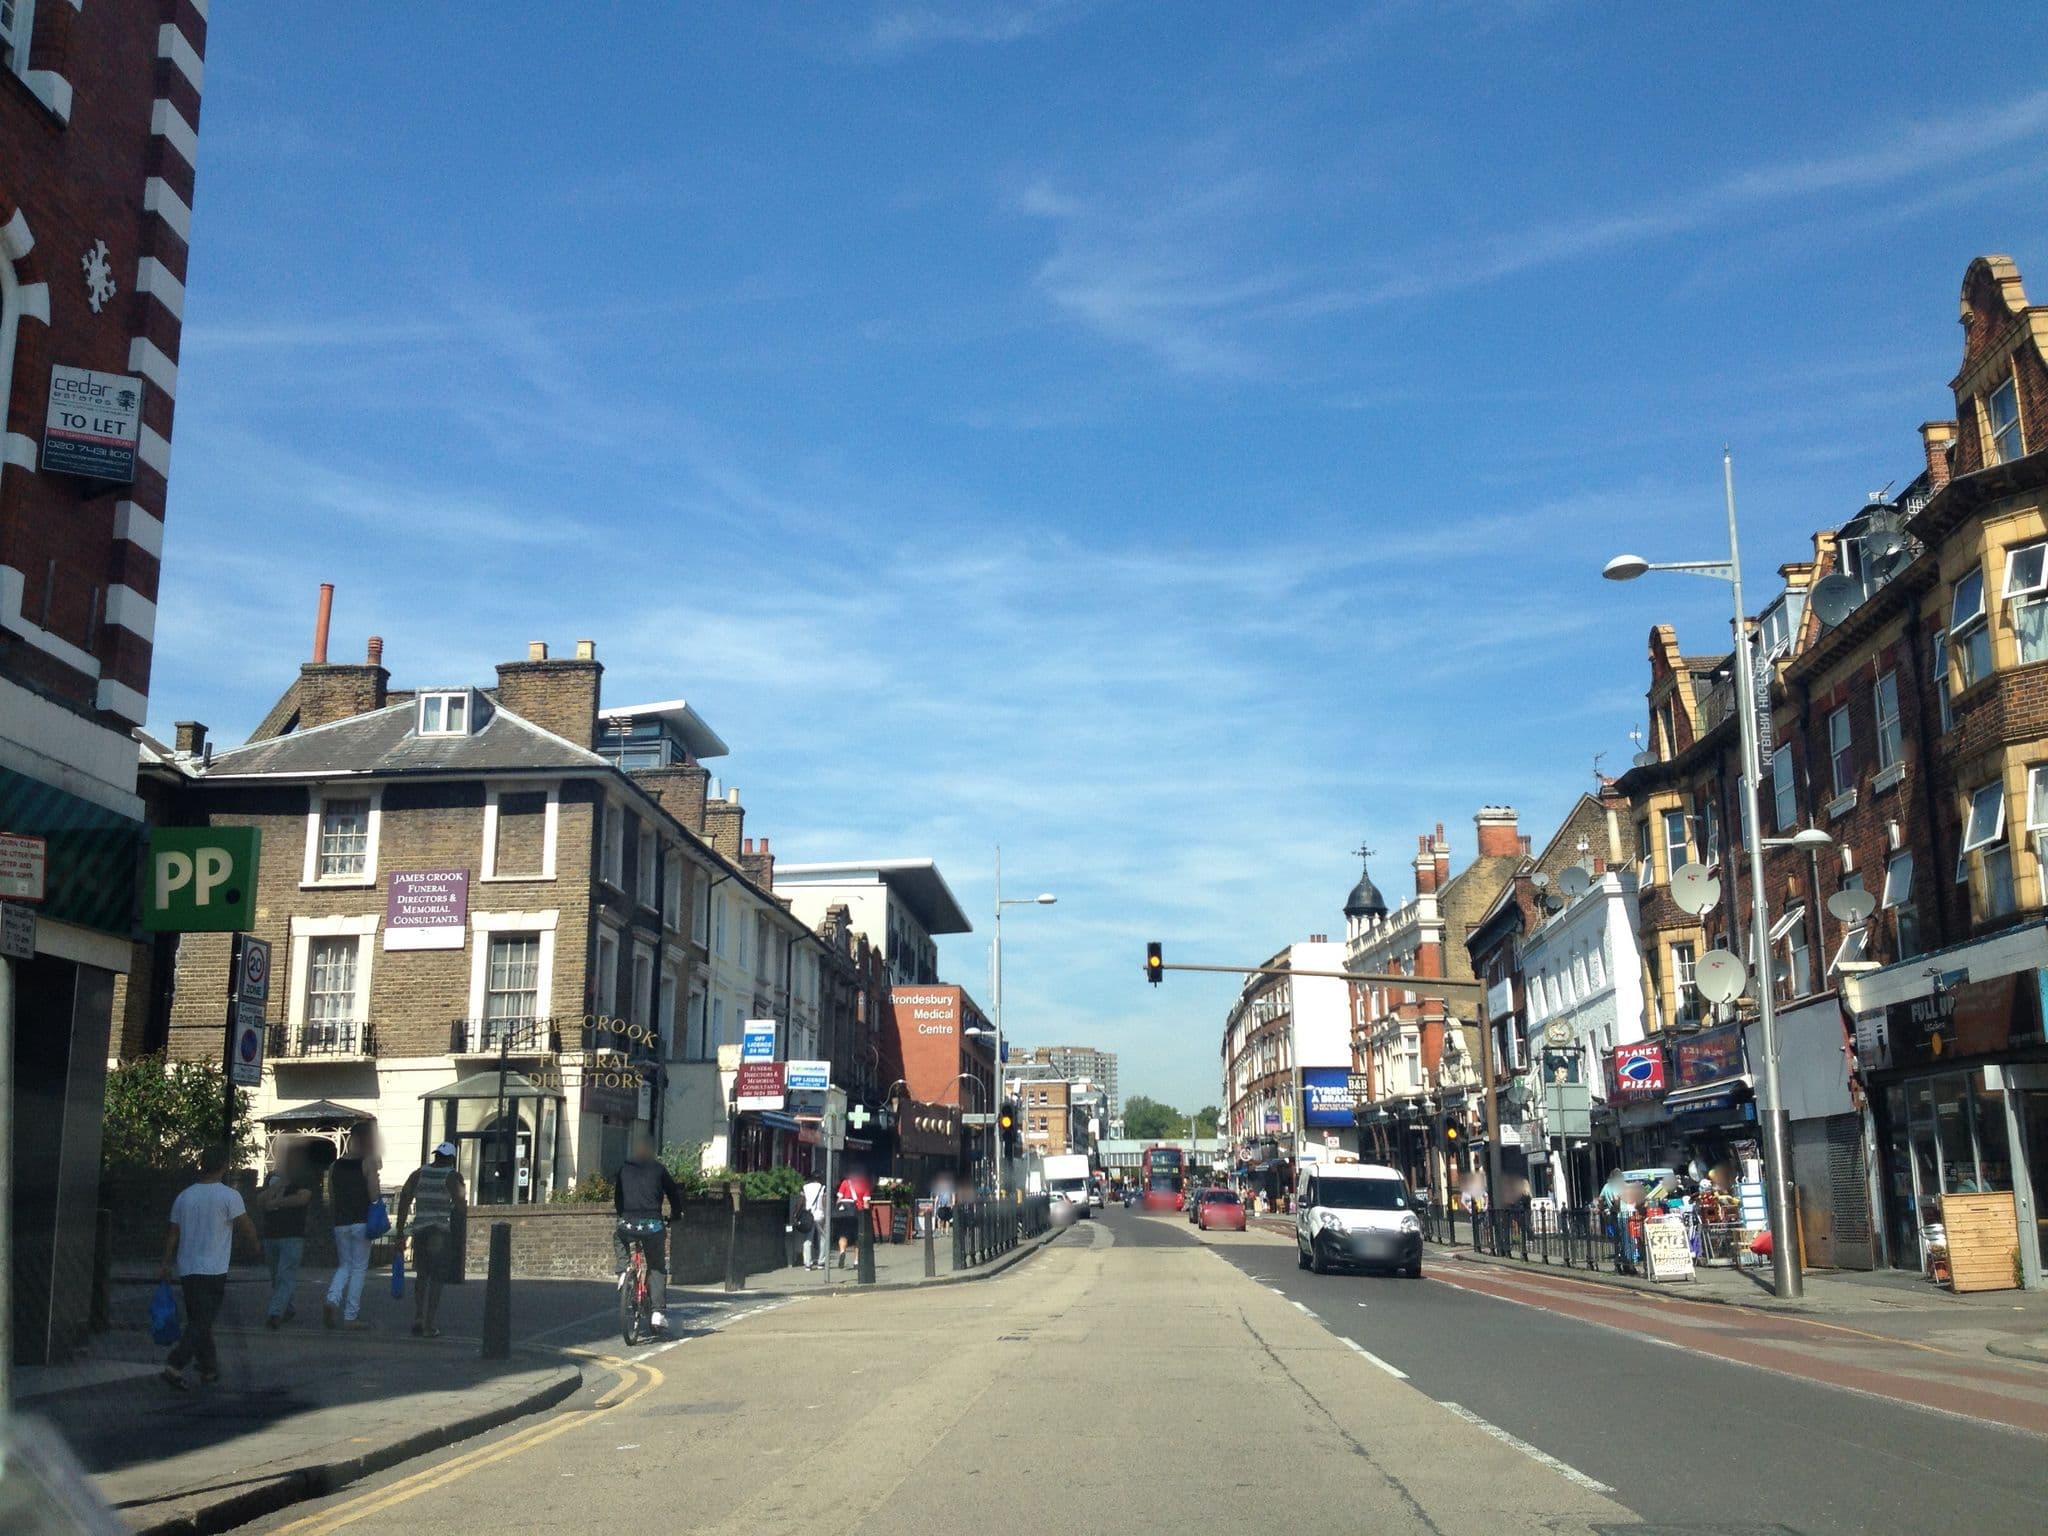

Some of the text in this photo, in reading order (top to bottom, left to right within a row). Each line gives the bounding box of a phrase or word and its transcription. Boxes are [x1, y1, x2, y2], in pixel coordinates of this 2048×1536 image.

[54, 373, 112, 397] cedar
[61, 412, 126, 434] TO LET
[47, 440, 75, 451] 020
[393, 872, 464, 884] JAMES CROOK
[408, 884, 449, 893] FUNERAL
[397, 893, 457, 904] DIRECTORS &
[402, 905, 451, 914] MEMORIAL
[393, 915, 459, 925] CONSULTANTS
[250, 954, 262, 974] 20
[245, 983, 262, 995] ZONE
[889, 994, 953, 1006] Brondesbury
[914, 1009, 954, 1019] Medical
[583, 1014, 658, 1048] CROOK
[919, 1024, 953, 1034] Centre
[1618, 1047, 1658, 1057] PLANET
[540, 1053, 634, 1069] FUNERAL
[1348, 1080, 1367, 1090] B&B
[1622, 1080, 1662, 1089] PIZZA
[1652, 1236, 1686, 1249] SALE
